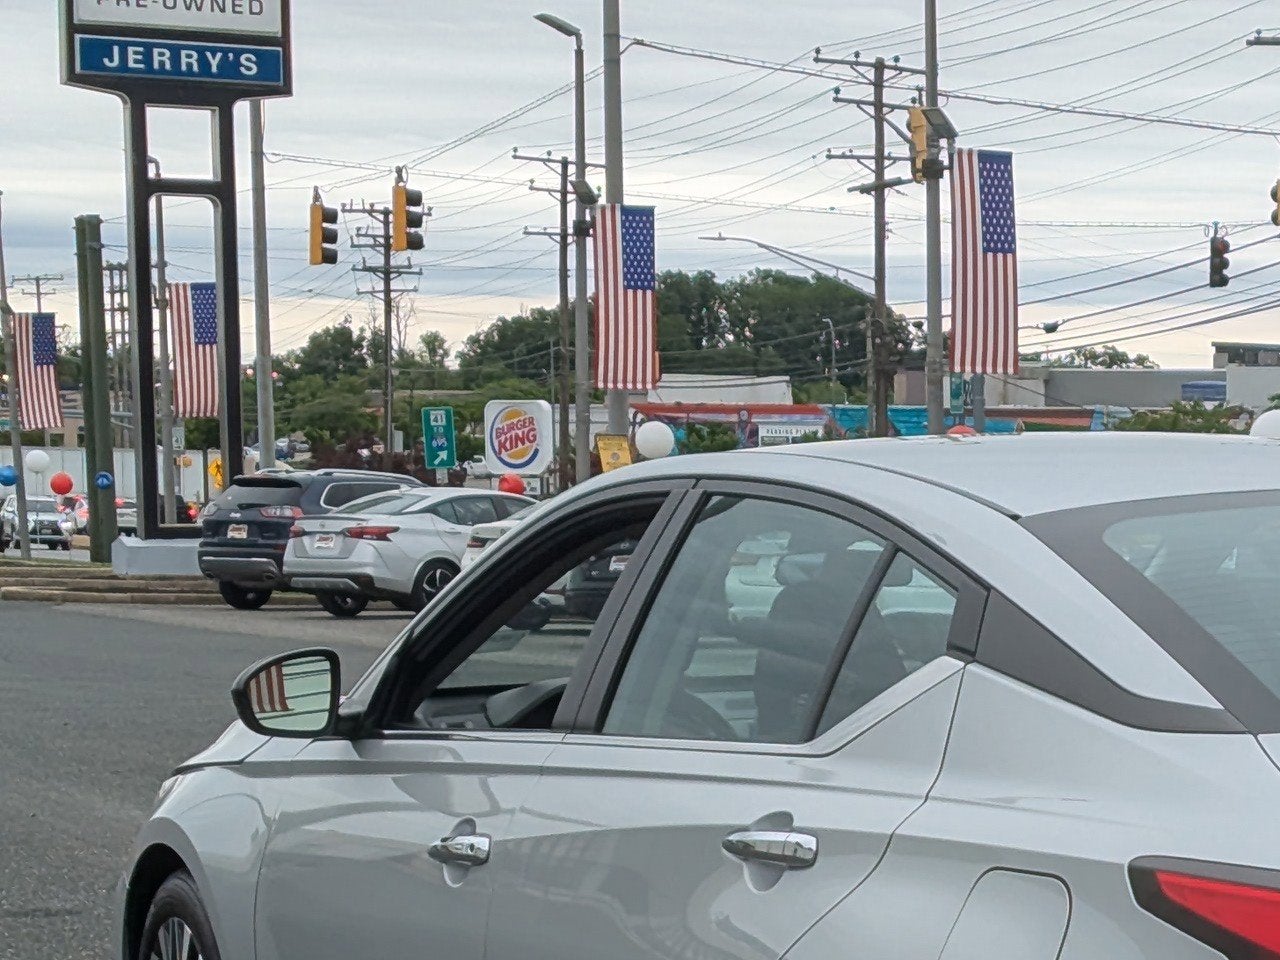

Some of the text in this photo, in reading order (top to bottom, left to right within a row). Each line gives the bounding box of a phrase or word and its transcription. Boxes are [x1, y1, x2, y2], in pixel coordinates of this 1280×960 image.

[102, 45, 258, 75] JERRY'S
[495, 416, 535, 440] BURGER
[496, 428, 537, 456] KING
